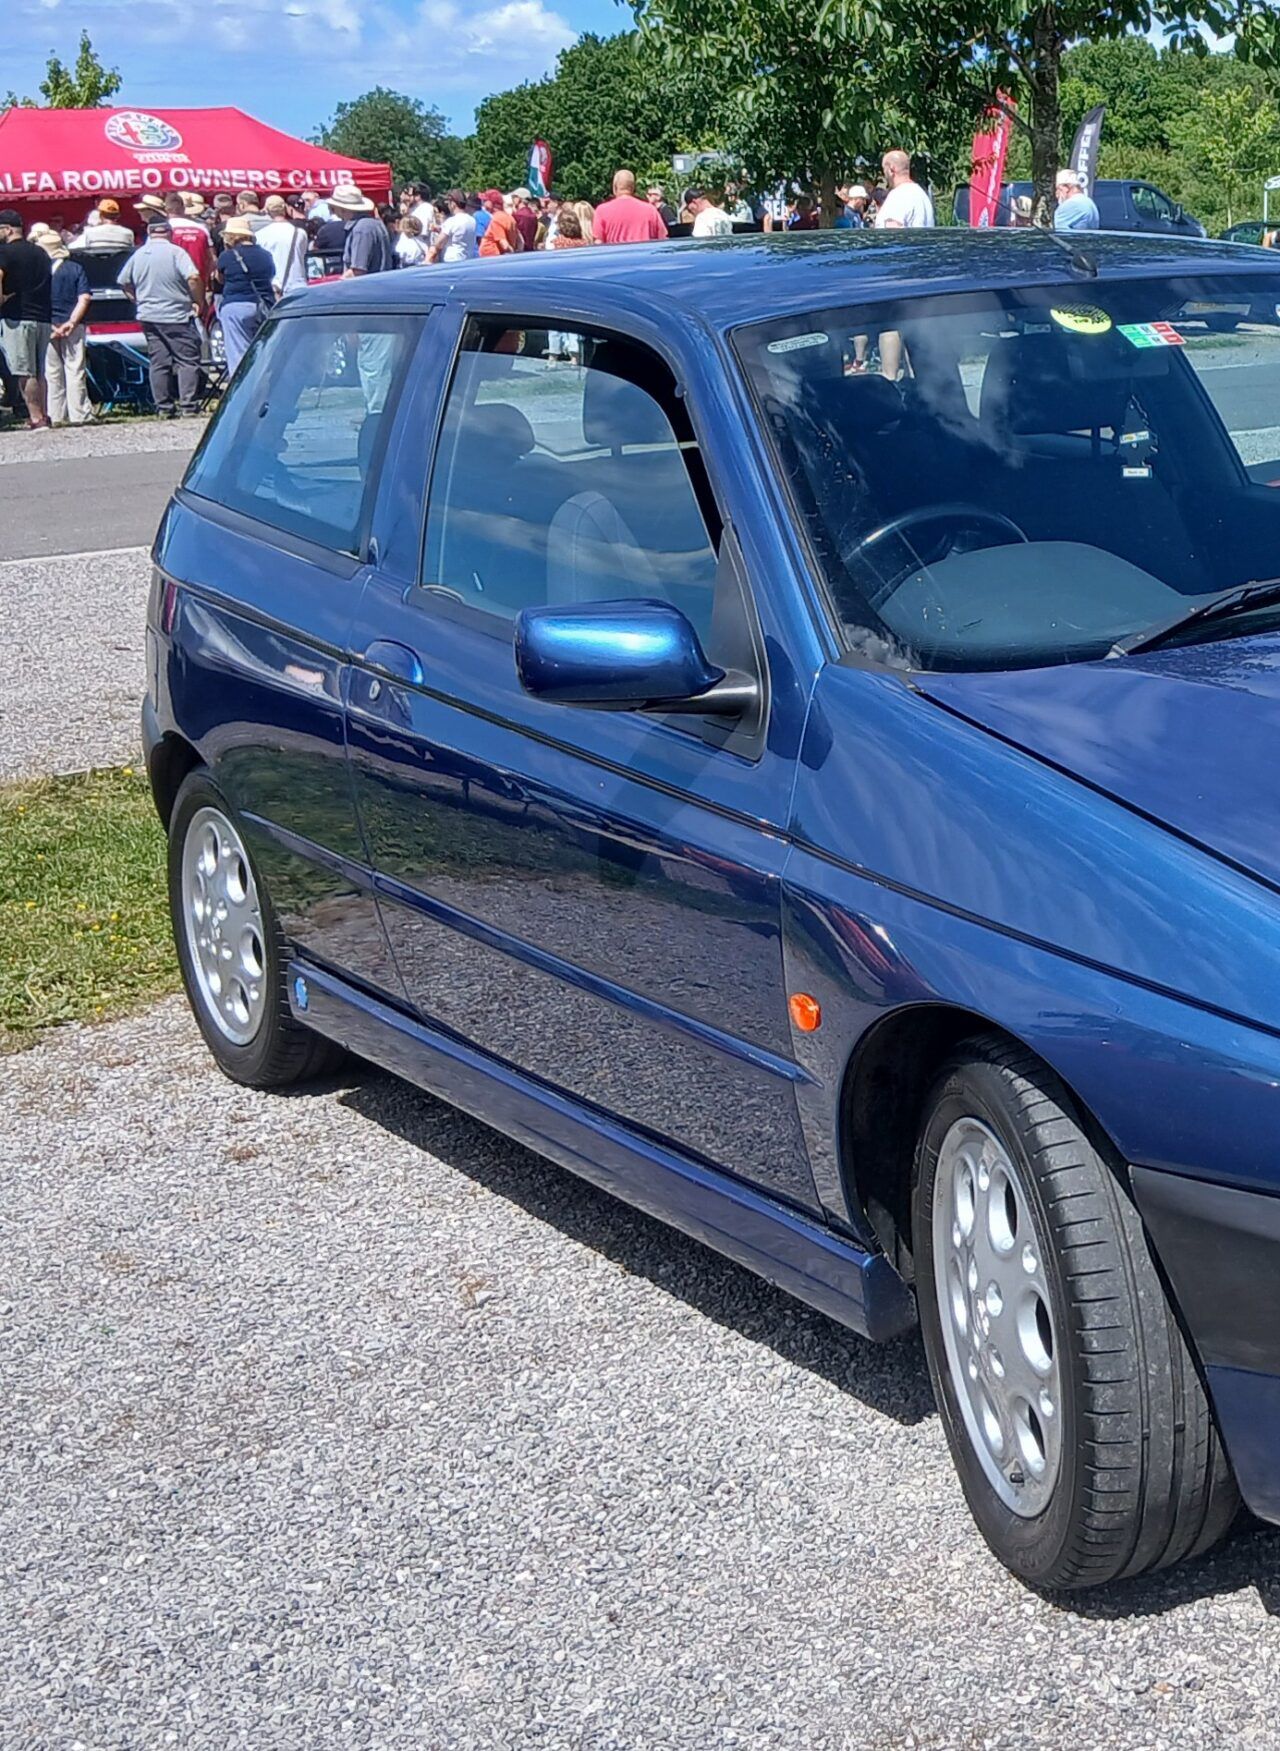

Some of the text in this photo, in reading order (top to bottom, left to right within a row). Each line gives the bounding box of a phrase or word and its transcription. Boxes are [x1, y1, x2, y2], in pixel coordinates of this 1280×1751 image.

[0, 167, 356, 193] LFA ROMEO OWNERS CLUB
